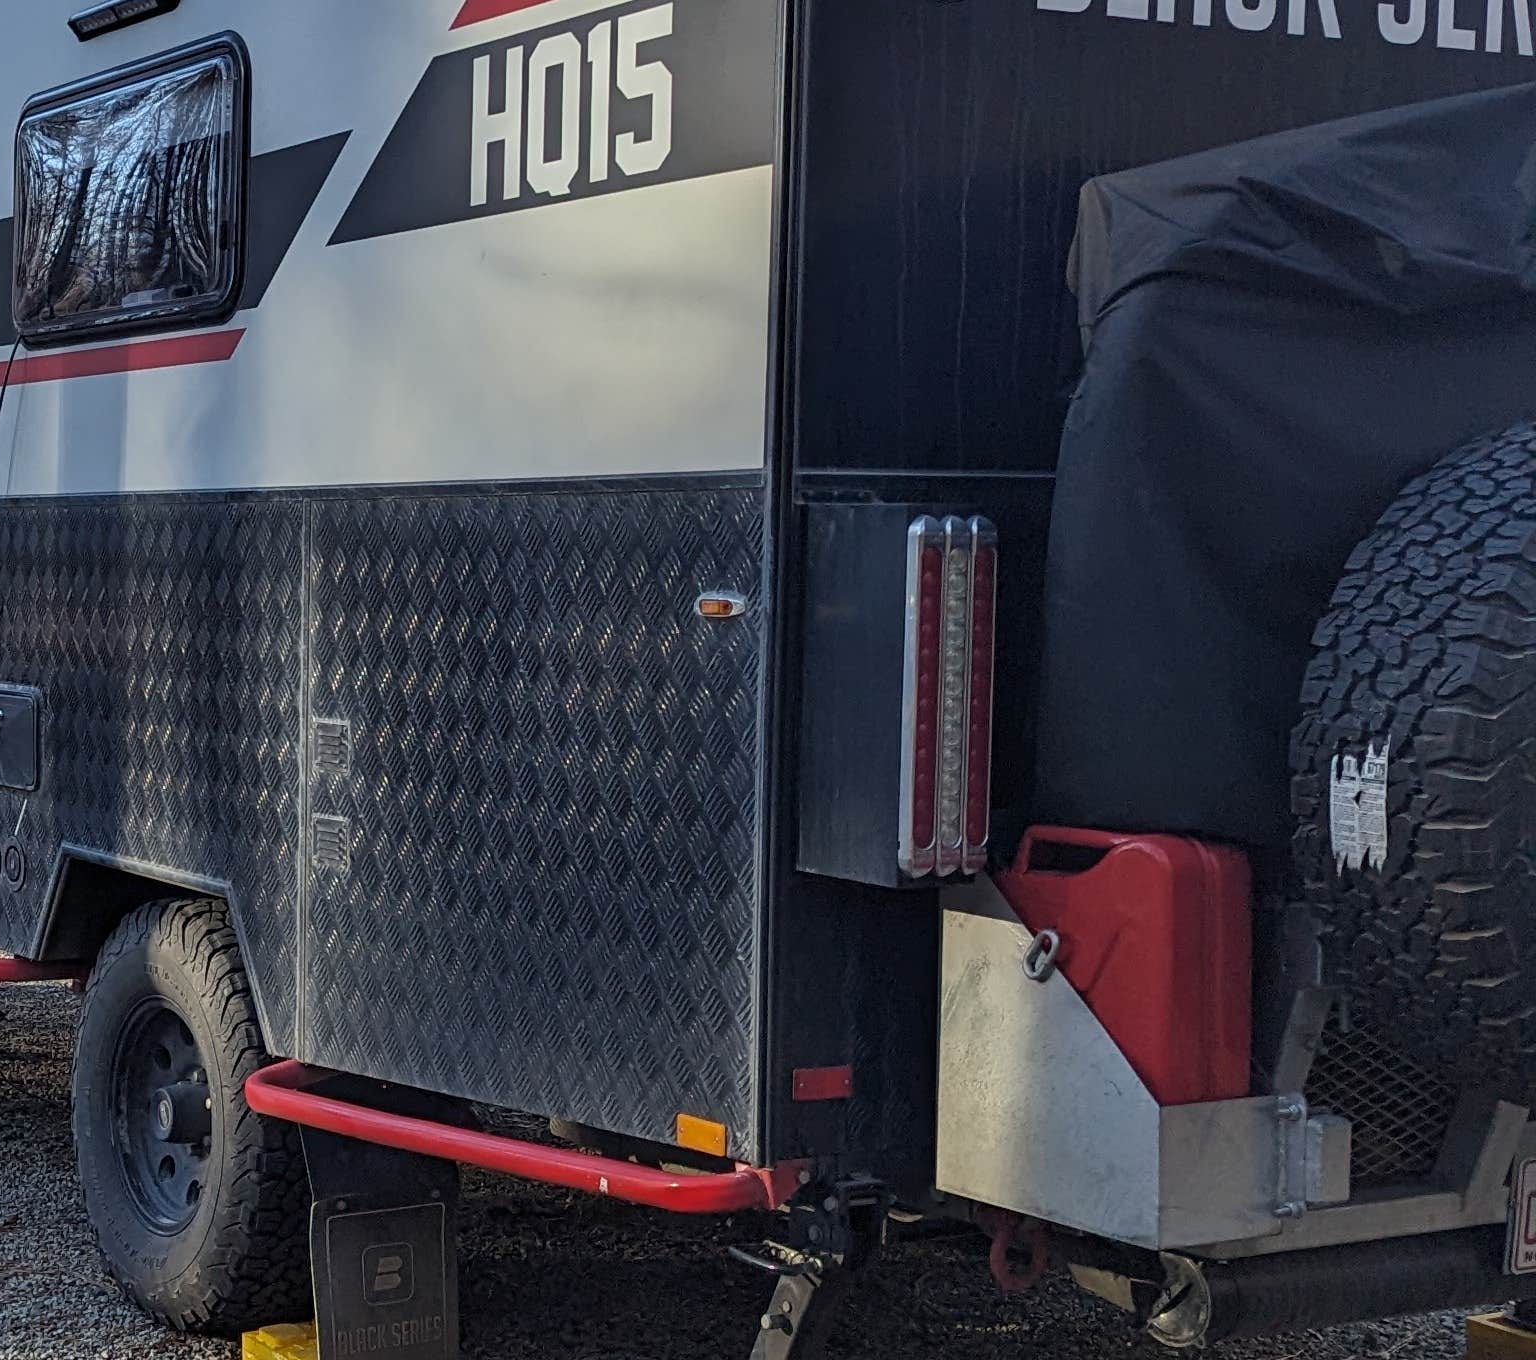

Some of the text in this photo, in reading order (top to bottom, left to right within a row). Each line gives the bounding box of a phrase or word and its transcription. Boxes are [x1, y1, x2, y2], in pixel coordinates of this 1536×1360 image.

[470, 2, 674, 207] HQ15
[337, 1315, 443, 1355] BLACK SERIES
